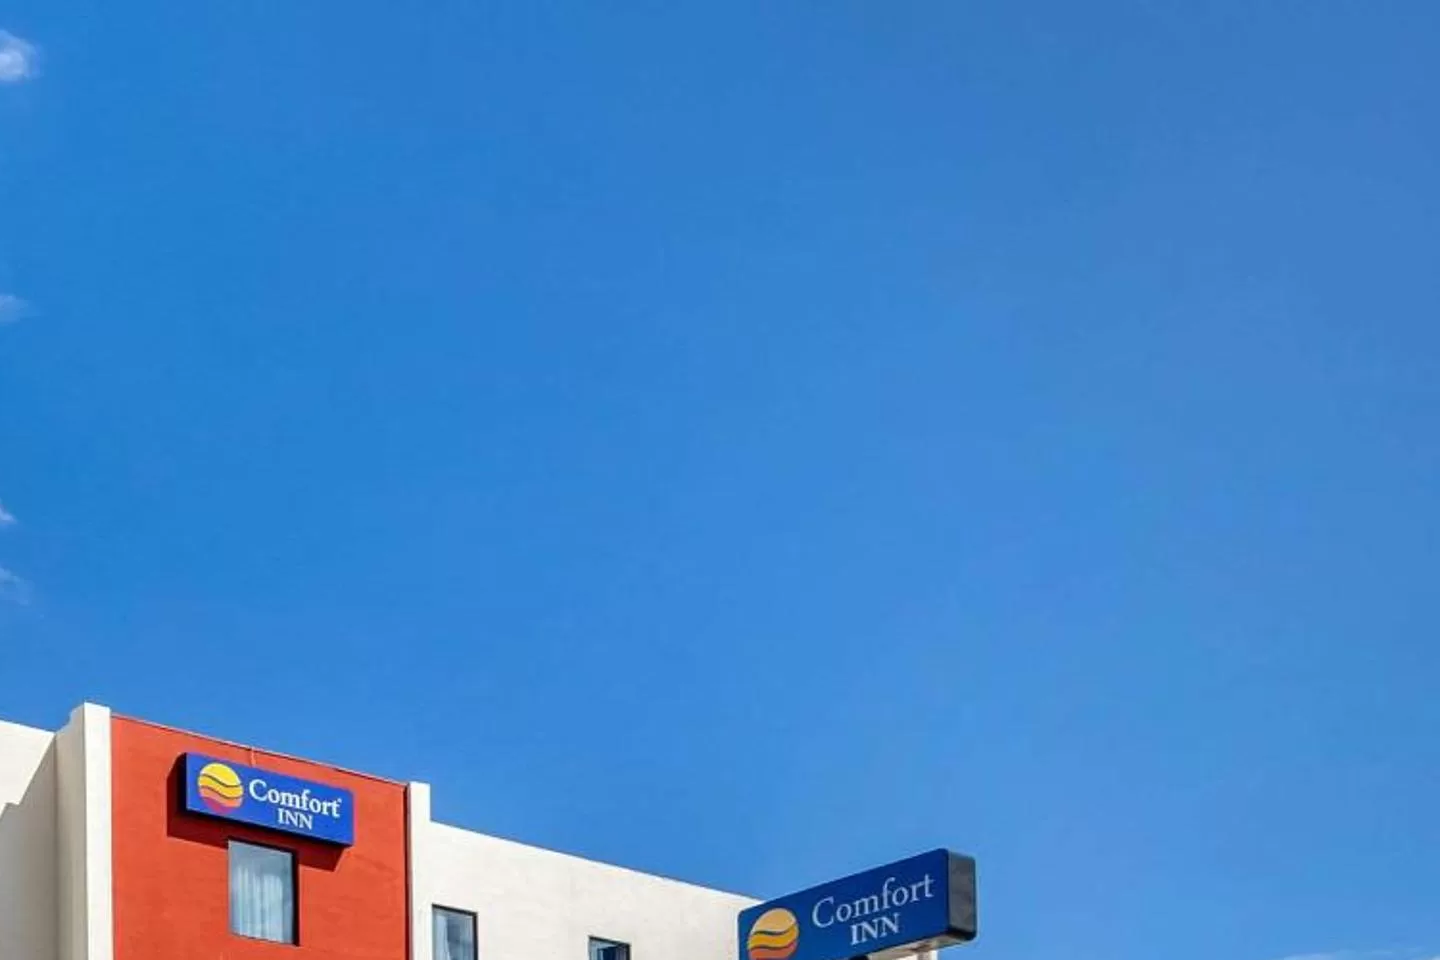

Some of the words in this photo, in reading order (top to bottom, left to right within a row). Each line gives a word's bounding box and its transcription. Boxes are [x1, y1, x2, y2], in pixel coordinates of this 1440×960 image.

[248, 778, 342, 818] Comfort
[277, 807, 313, 830] INN
[812, 874, 935, 929] Comfort
[849, 912, 901, 946] INN
